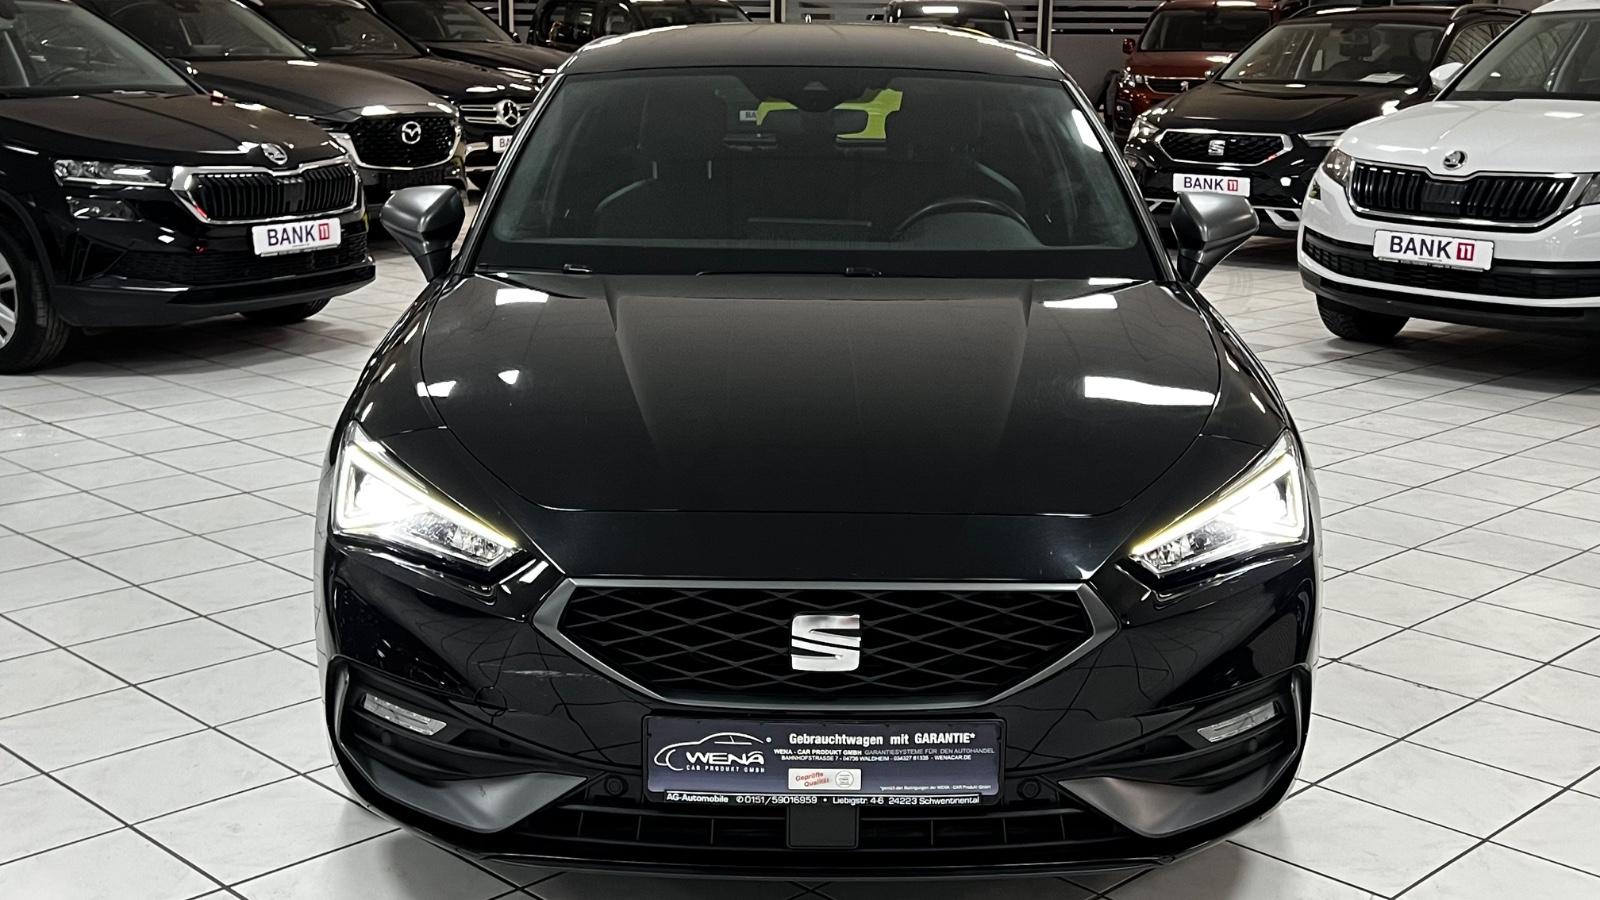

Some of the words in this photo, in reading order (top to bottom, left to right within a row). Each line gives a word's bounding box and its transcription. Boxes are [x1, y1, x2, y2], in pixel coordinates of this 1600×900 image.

[1184, 176, 1224, 191] BANK
[267, 224, 315, 246] BANK
[1390, 235, 1453, 259] BANK
[1456, 242, 1475, 261] 11
[789, 733, 884, 747] Gebrauchtwagen
[890, 733, 909, 745] mit
[686, 751, 765, 765] WENA
[666, 793, 729, 803] AG-Automobile
[888, 797, 917, 805] 24223
[918, 796, 980, 805] Schwentinental
